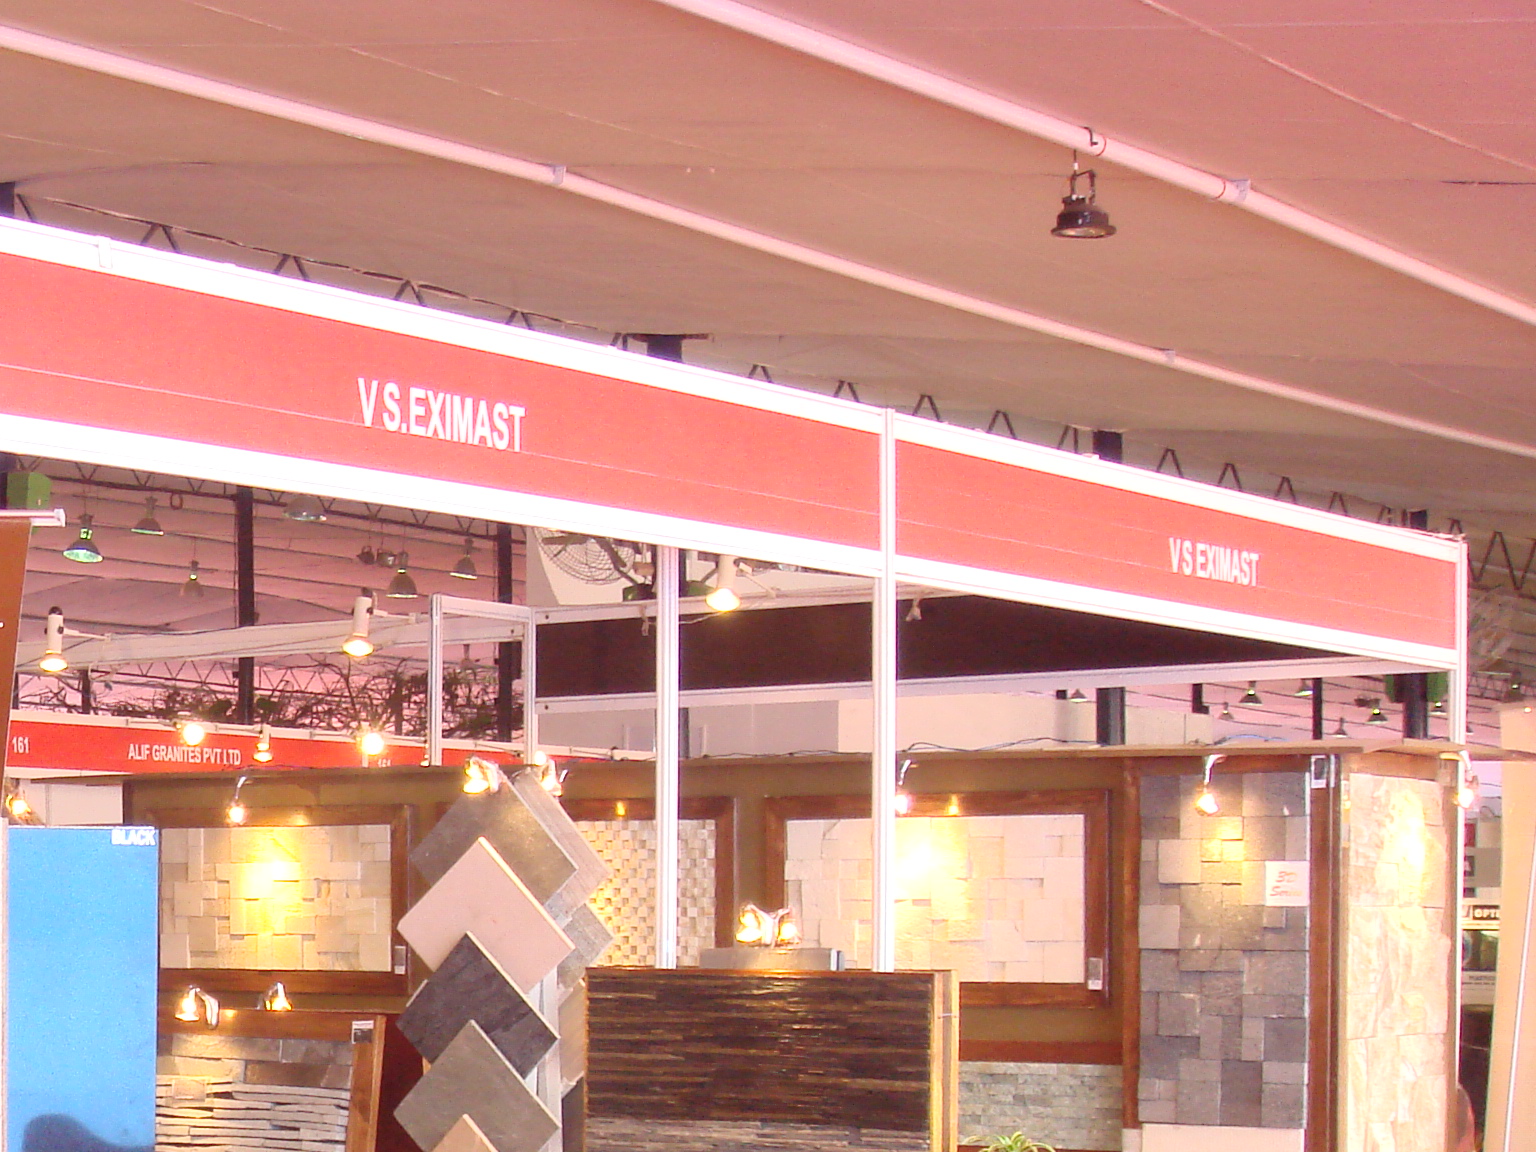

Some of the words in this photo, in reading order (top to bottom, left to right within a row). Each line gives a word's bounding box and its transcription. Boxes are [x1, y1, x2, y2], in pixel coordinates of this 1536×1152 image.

[1196, 542, 1259, 587] EXIMAST
[12, 736, 29, 754] 161
[127, 743, 150, 760] ALIF
[152, 744, 202, 764] GRANITES
[203, 747, 222, 765] PVT
[224, 748, 241, 766] LTD
[111, 828, 156, 846] BLACK
